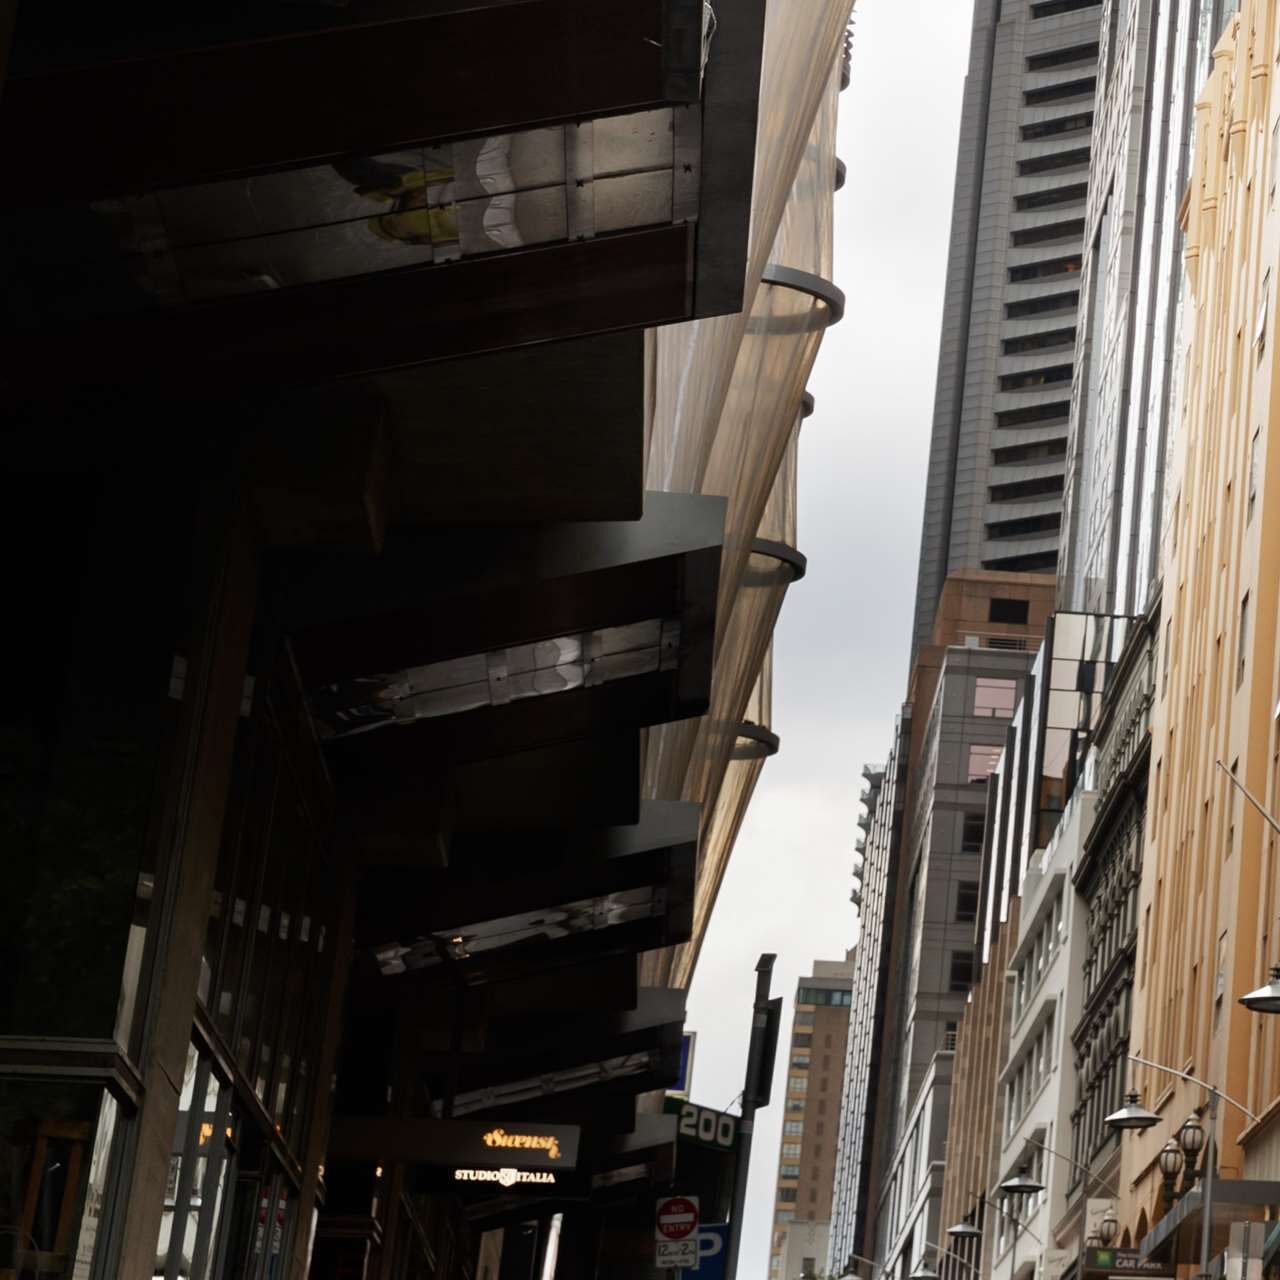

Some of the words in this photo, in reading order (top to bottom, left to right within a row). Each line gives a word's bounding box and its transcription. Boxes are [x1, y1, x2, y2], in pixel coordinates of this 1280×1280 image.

[679, 1104, 735, 1147] 200
[455, 1169, 498, 1182] STUDIO
[516, 1172, 555, 1184] ITALIA
[671, 1204, 686, 1212] NO
[663, 1223, 691, 1233] ENTRY
[1115, 1258, 1136, 1270] CAR
